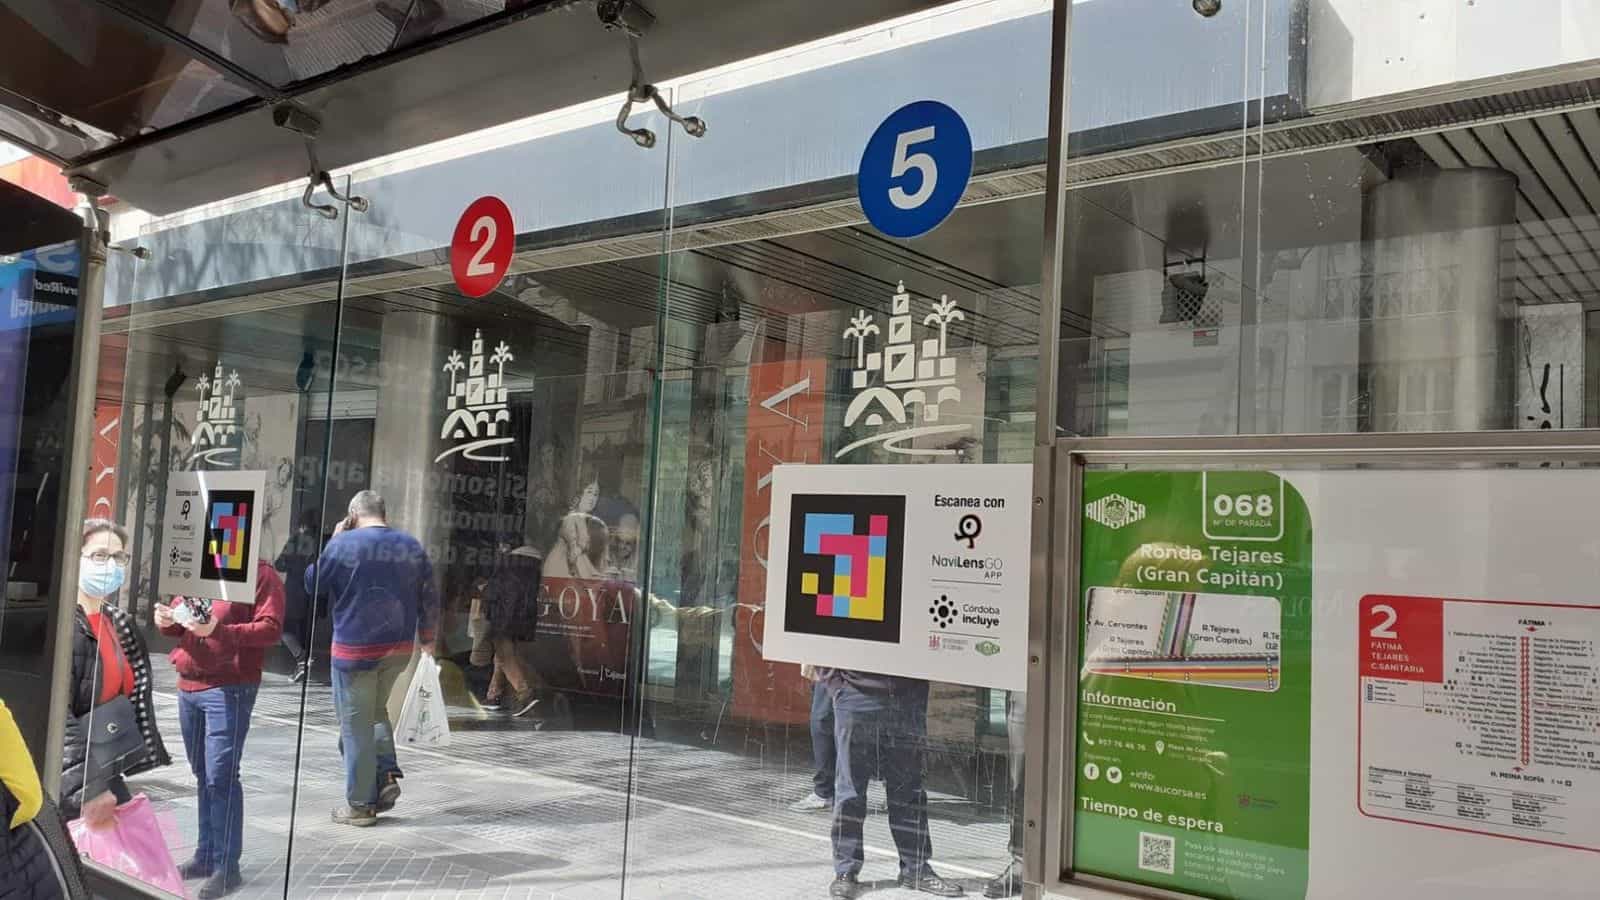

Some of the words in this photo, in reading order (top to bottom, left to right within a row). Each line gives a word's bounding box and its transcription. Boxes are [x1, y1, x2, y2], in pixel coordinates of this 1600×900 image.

[888, 126, 938, 210] 5
[467, 216, 496, 276] 2
[934, 494, 981, 508] Escanea
[984, 497, 1005, 508] con
[1213, 494, 1274, 517] 068
[1238, 519, 1272, 528] PARADA
[931, 555, 1003, 571] NaviLensGO
[1140, 543, 1202, 561] Ronda
[1208, 545, 1283, 566] Tejares
[984, 571, 1002, 580] APP
[1136, 565, 1190, 583] (Gran
[1196, 568, 1283, 590] Capitán)
[537, 583, 630, 625] GOYA
[962, 604, 1000, 615] Córdoba
[962, 614, 1000, 628] incluye
[1107, 620, 1149, 630] Cervantes
[1369, 604, 1398, 639] 2
[1370, 652, 1410, 662] TEJARES
[1082, 690, 1177, 713] Información
[1081, 797, 1138, 818] Tiempo
[1143, 808, 1163, 823] de
[1167, 815, 1224, 833] espera
